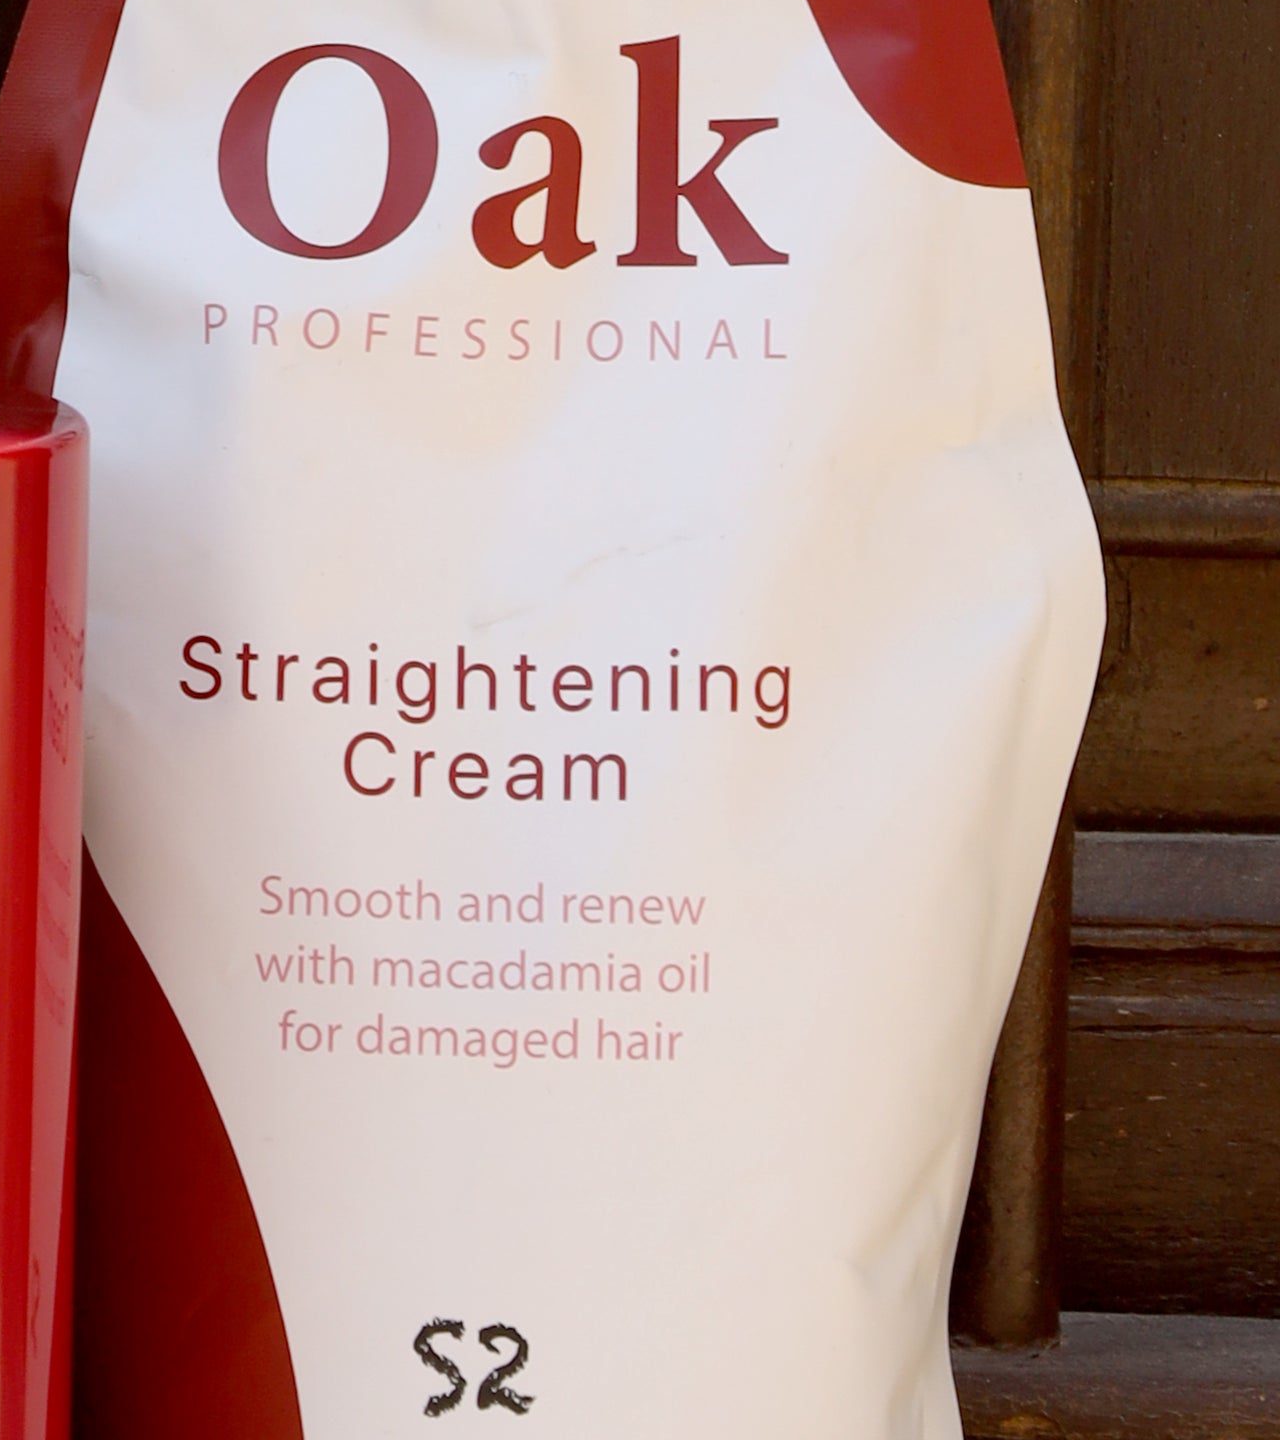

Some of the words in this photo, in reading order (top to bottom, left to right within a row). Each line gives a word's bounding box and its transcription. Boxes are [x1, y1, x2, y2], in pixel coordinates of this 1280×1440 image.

[217, 35, 790, 271] Oak
[203, 304, 788, 361] PROFESSIONAL
[179, 636, 792, 729] Straightening
[342, 732, 629, 802] Cream
[259, 874, 440, 921] Smooth
[457, 882, 544, 924] and
[561, 890, 706, 926] renew
[254, 944, 355, 986] with
[371, 950, 642, 993] macadamia
[657, 952, 711, 995] oil
[278, 1010, 342, 1054] for
[356, 1014, 578, 1069] damaged
[596, 1019, 683, 1061] hair
[413, 1318, 536, 1417] S2
